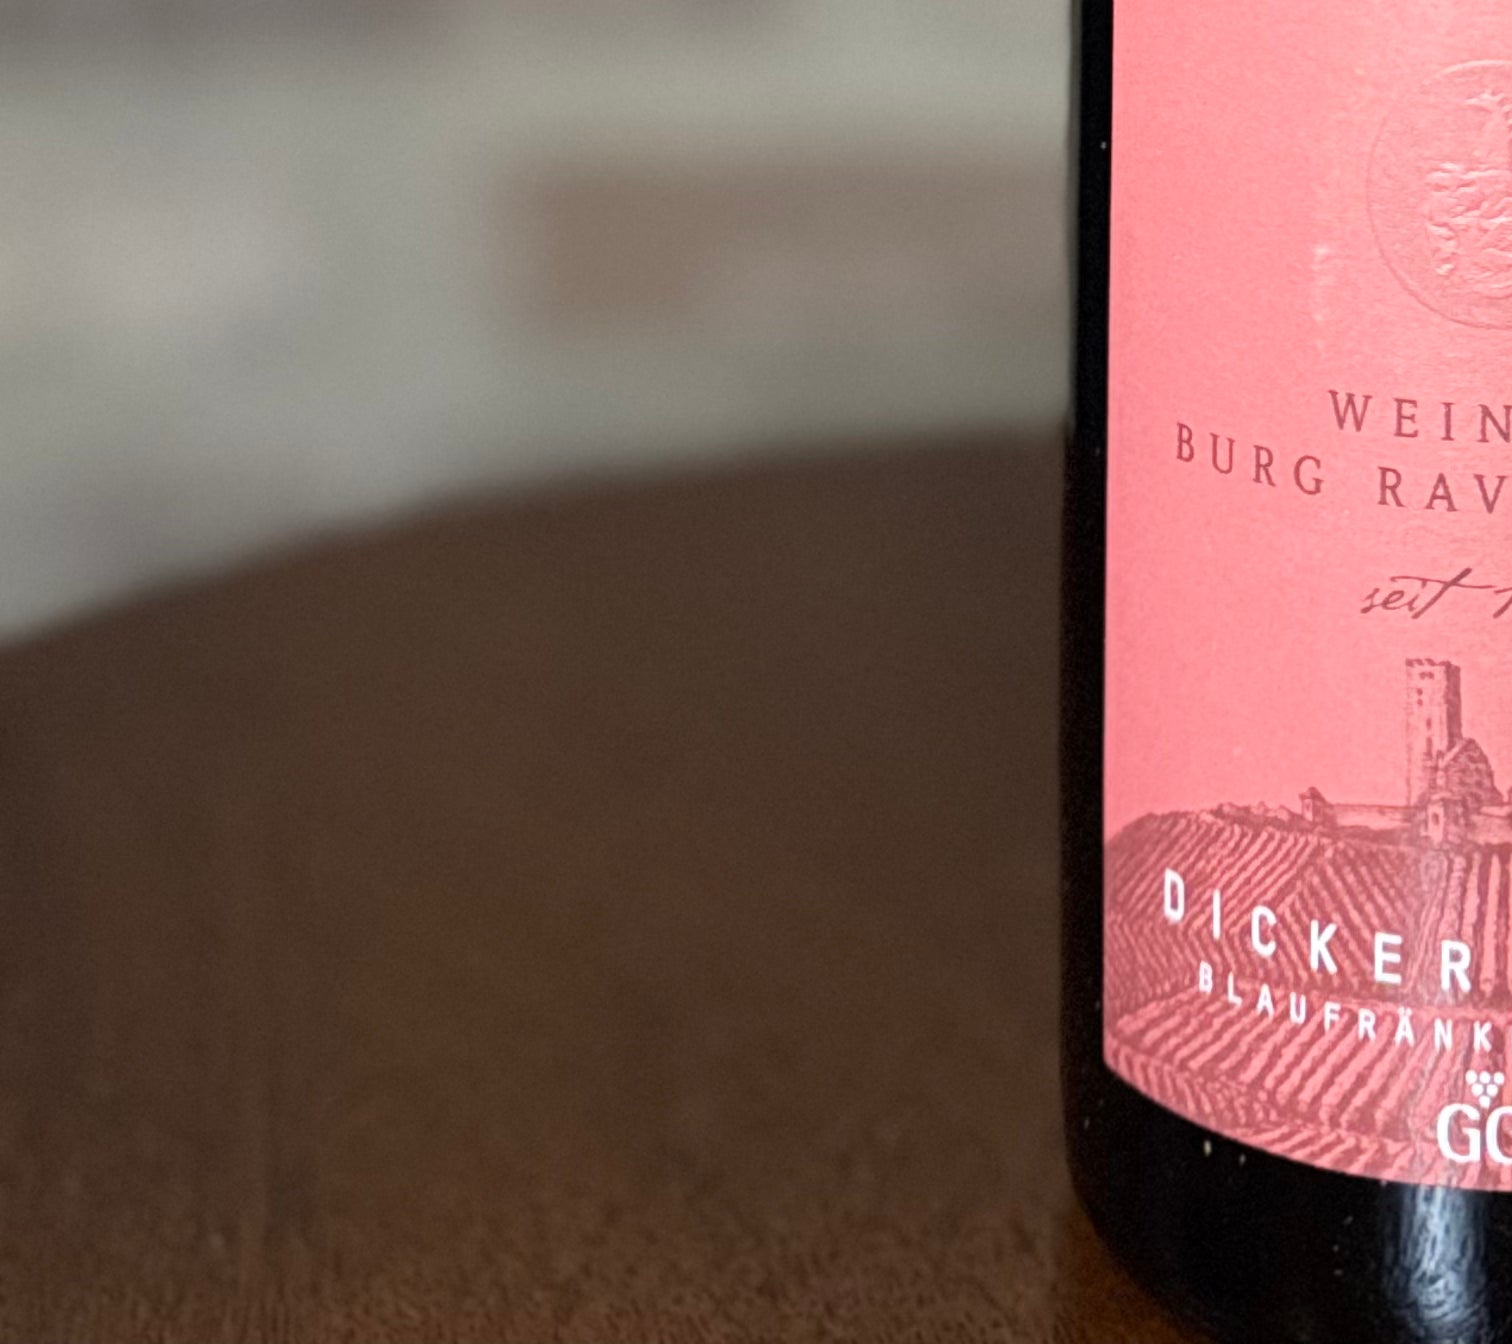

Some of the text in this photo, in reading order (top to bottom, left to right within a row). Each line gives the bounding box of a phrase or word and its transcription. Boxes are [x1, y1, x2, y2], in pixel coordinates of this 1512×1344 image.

[1175, 421, 1326, 496] BURG
[1361, 567, 1494, 620] seit
[1162, 868, 1473, 993] DICKER
